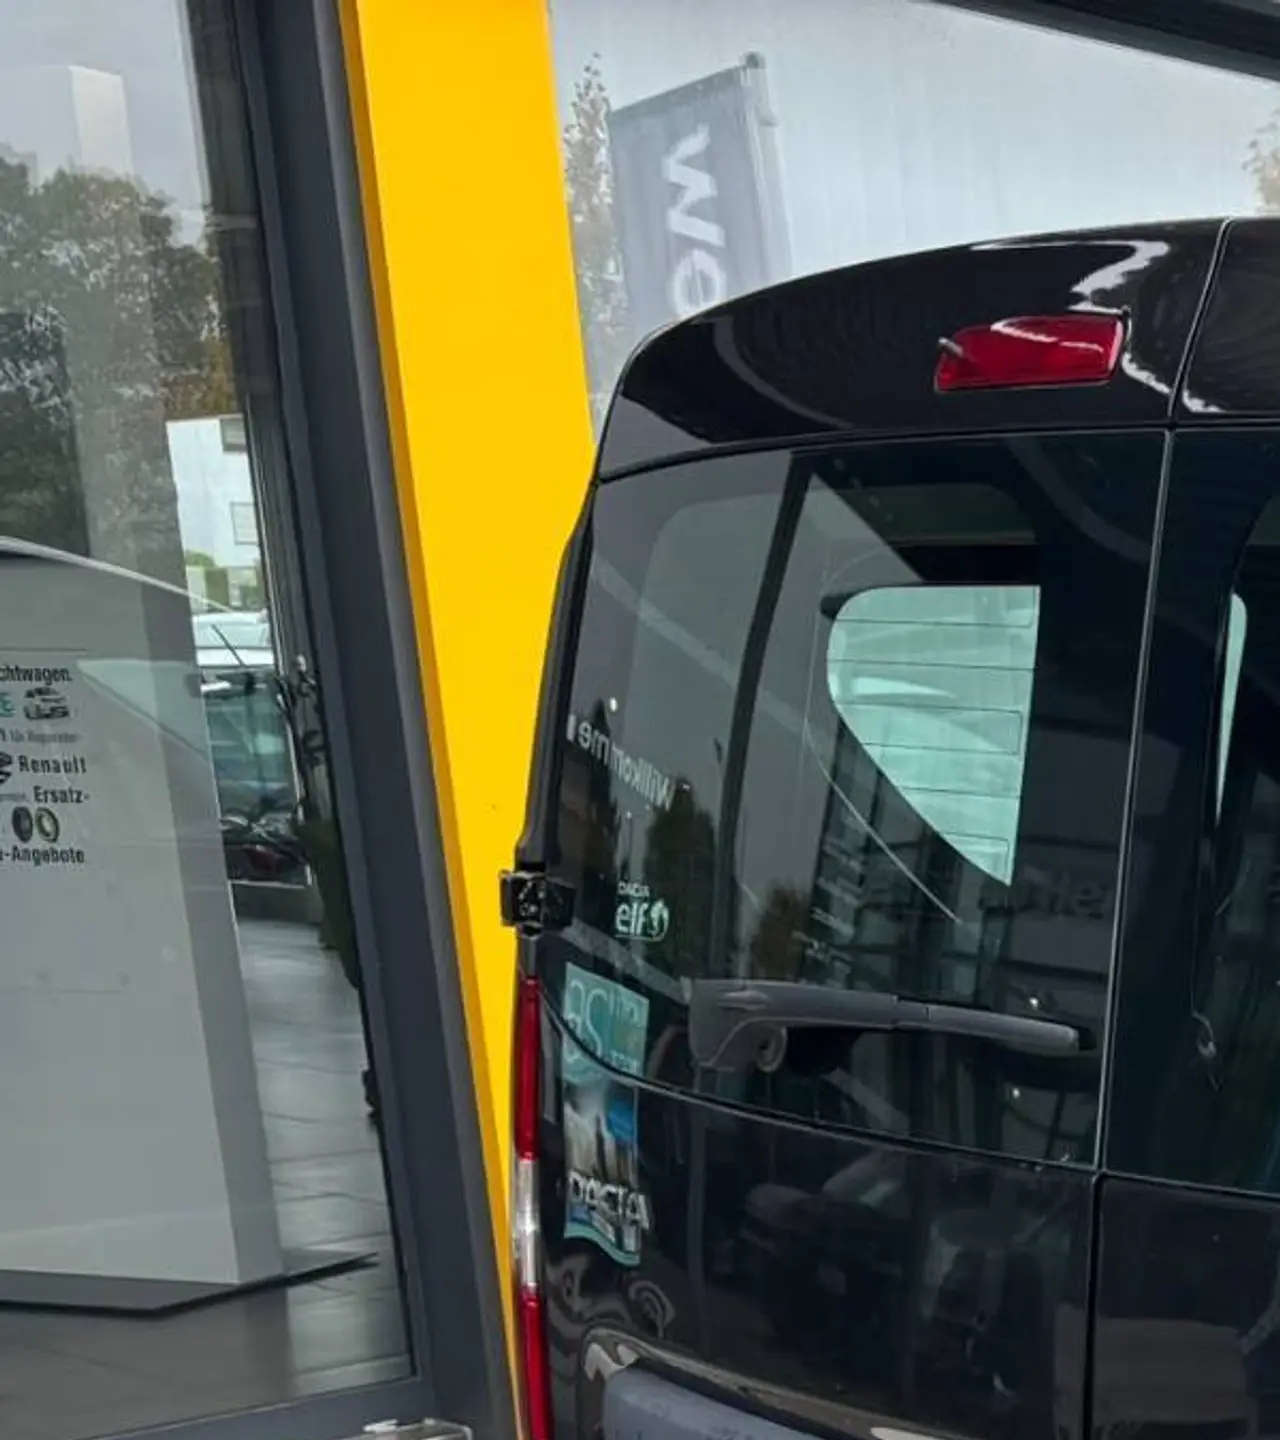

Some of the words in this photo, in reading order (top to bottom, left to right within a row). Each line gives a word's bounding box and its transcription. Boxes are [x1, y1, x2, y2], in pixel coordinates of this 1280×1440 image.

[18, 755, 87, 774] Renault
[33, 785, 90, 804] Ersatz-
[568, 1169, 652, 1233] DACIA
